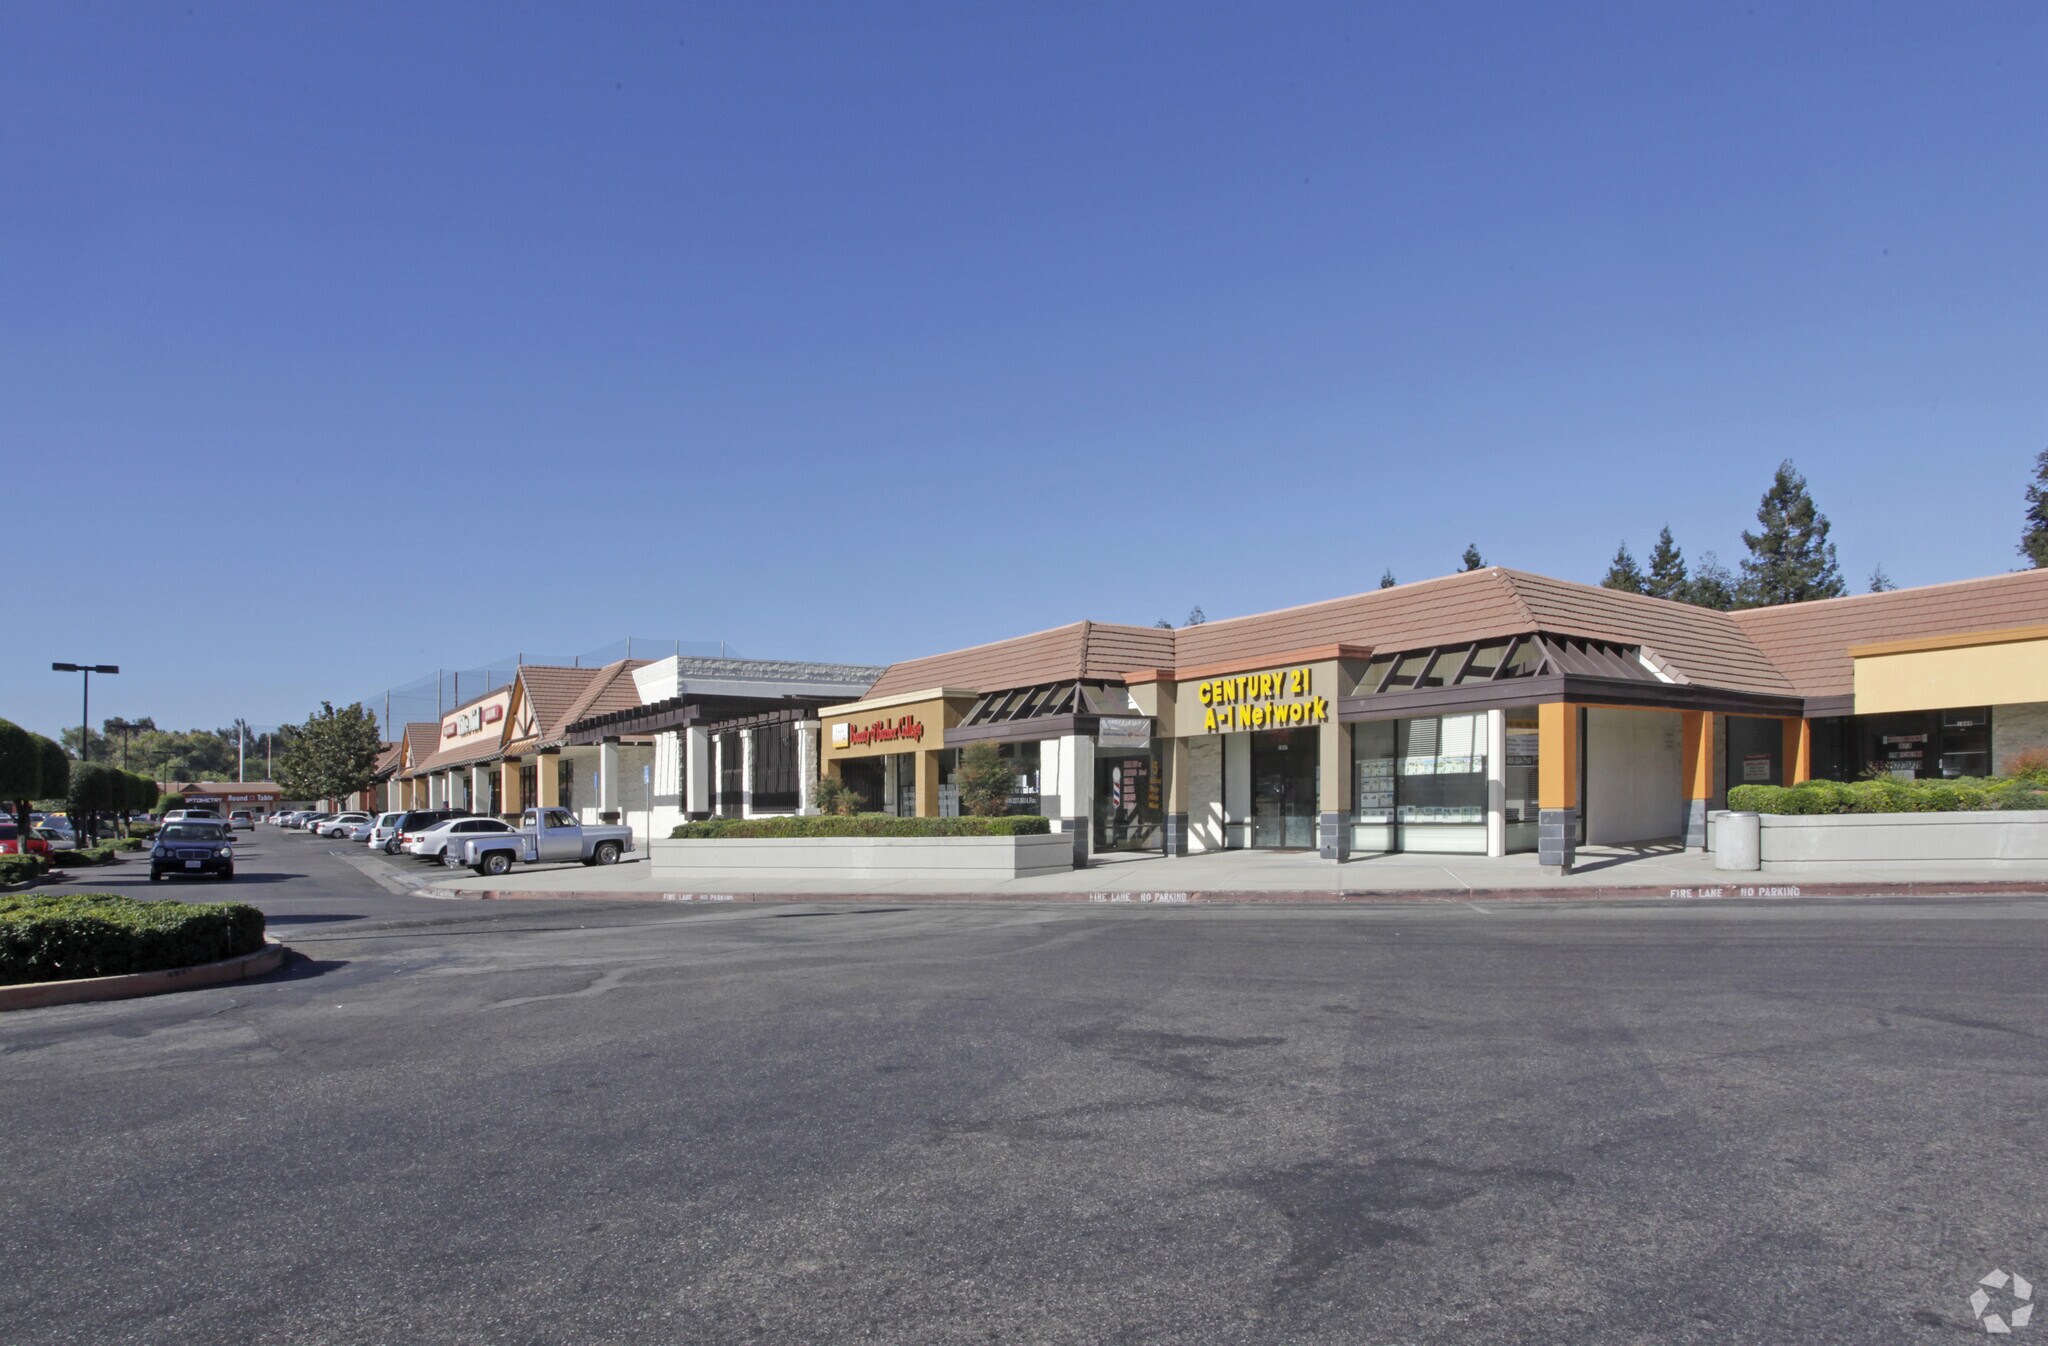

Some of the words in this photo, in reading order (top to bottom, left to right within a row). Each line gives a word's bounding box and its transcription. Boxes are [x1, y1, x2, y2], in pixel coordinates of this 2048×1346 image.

[1199, 672, 1284, 704] CENTURY
[1290, 668, 1309, 693] 21
[1204, 706, 1234, 730] A-1
[1240, 696, 1326, 726] Network
[850, 724, 871, 745] Beauty
[876, 720, 898, 740] Barber
[898, 714, 923, 742] College
[663, 893, 676, 901] FIRE
[679, 893, 693, 901] LANE
[1089, 893, 1107, 902] FIRE
[1110, 893, 1131, 902] LANE
[1140, 892, 1152, 902] NO
[1155, 892, 1187, 902] PARKING
[1671, 889, 1693, 898] FIRE
[1698, 888, 1723, 898] LANE
[1740, 887, 1754, 897] NO
[1759, 887, 1800, 897] PARKING
